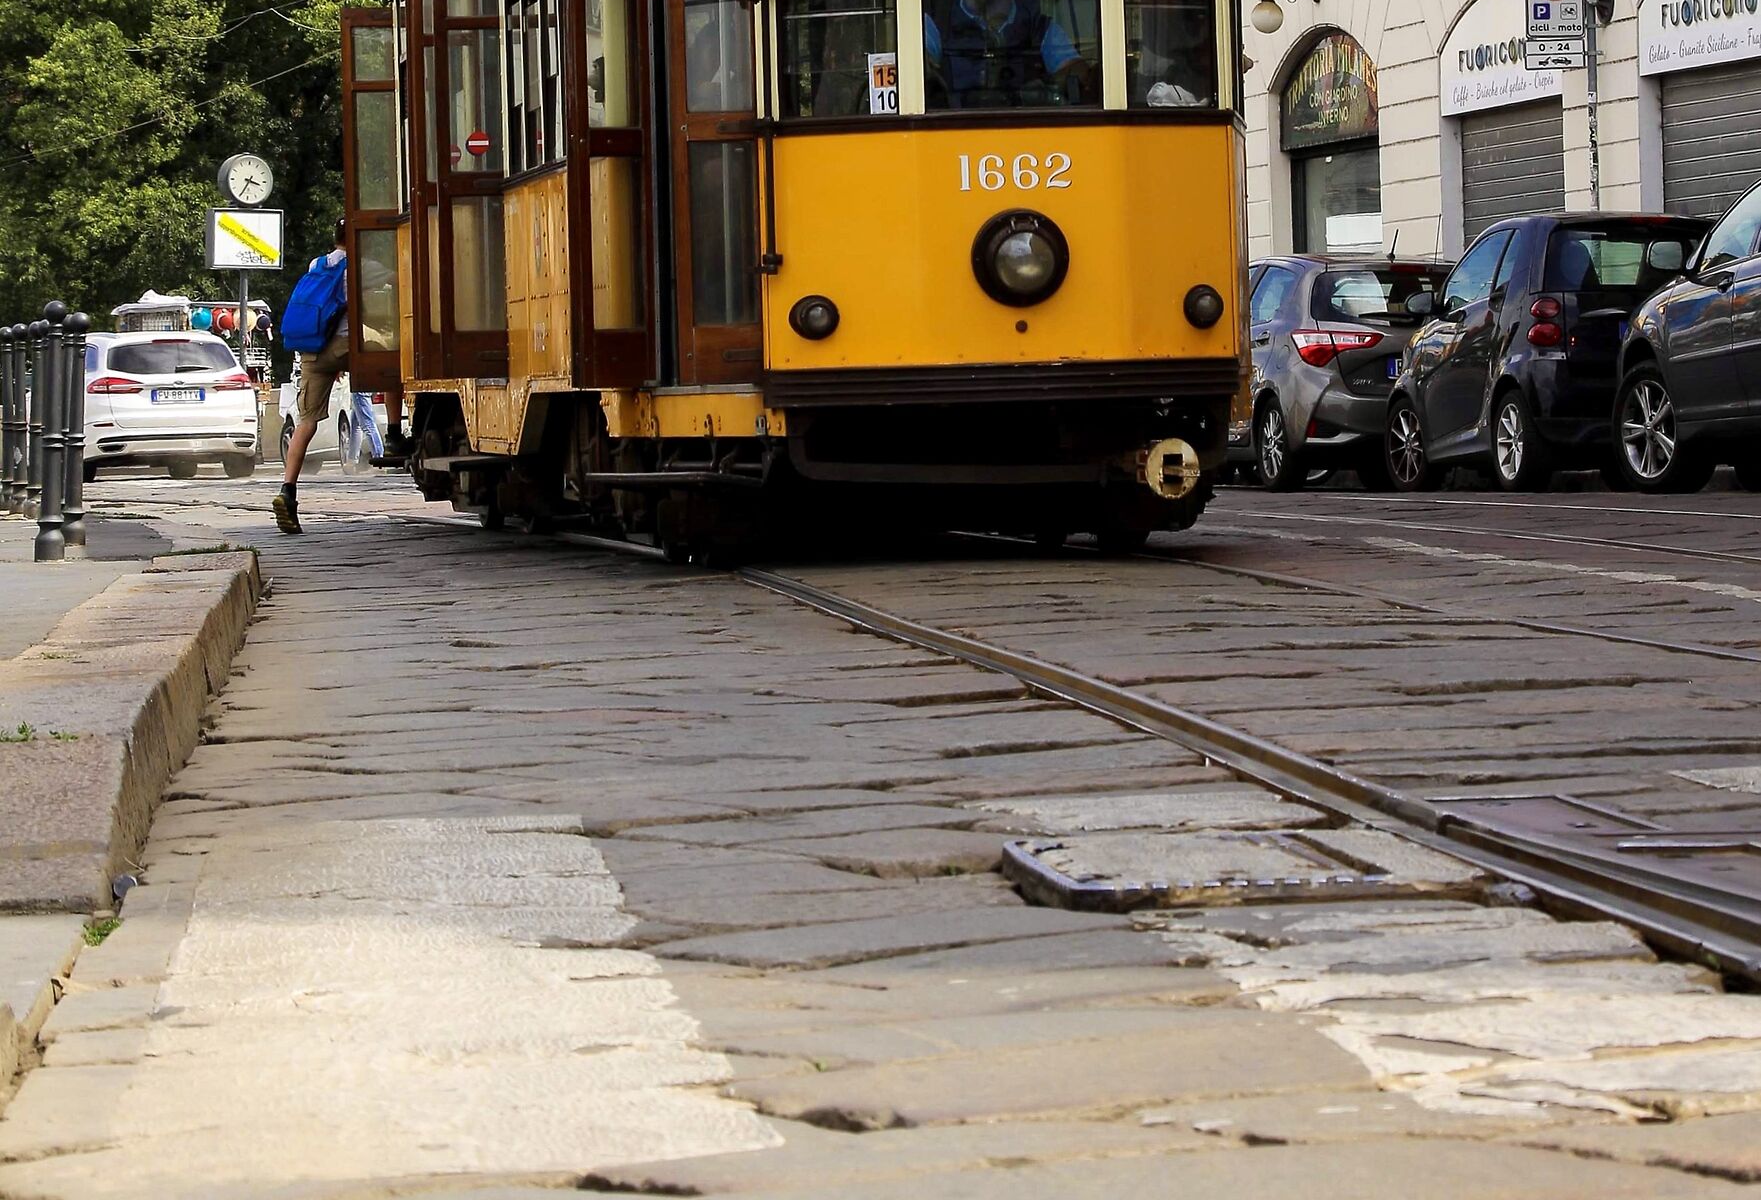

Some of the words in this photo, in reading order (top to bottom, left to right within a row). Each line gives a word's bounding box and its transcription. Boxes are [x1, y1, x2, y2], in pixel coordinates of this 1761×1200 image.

[1530, 23, 1550, 32] cicli
[1558, 23, 1582, 32] moto
[1458, 36, 1527, 73] FUORICON
[1557, 42, 1570, 51] 24
[1679, 39, 1706, 59] Granite
[1706, 32, 1739, 55] Siciliane
[876, 67, 897, 87] 15
[1287, 43, 1335, 116] TRATTORIA
[877, 90, 898, 110] 10
[1309, 91, 1325, 108] CON
[1318, 105, 1349, 128] INTERNO
[958, 152, 1073, 192] 1662
